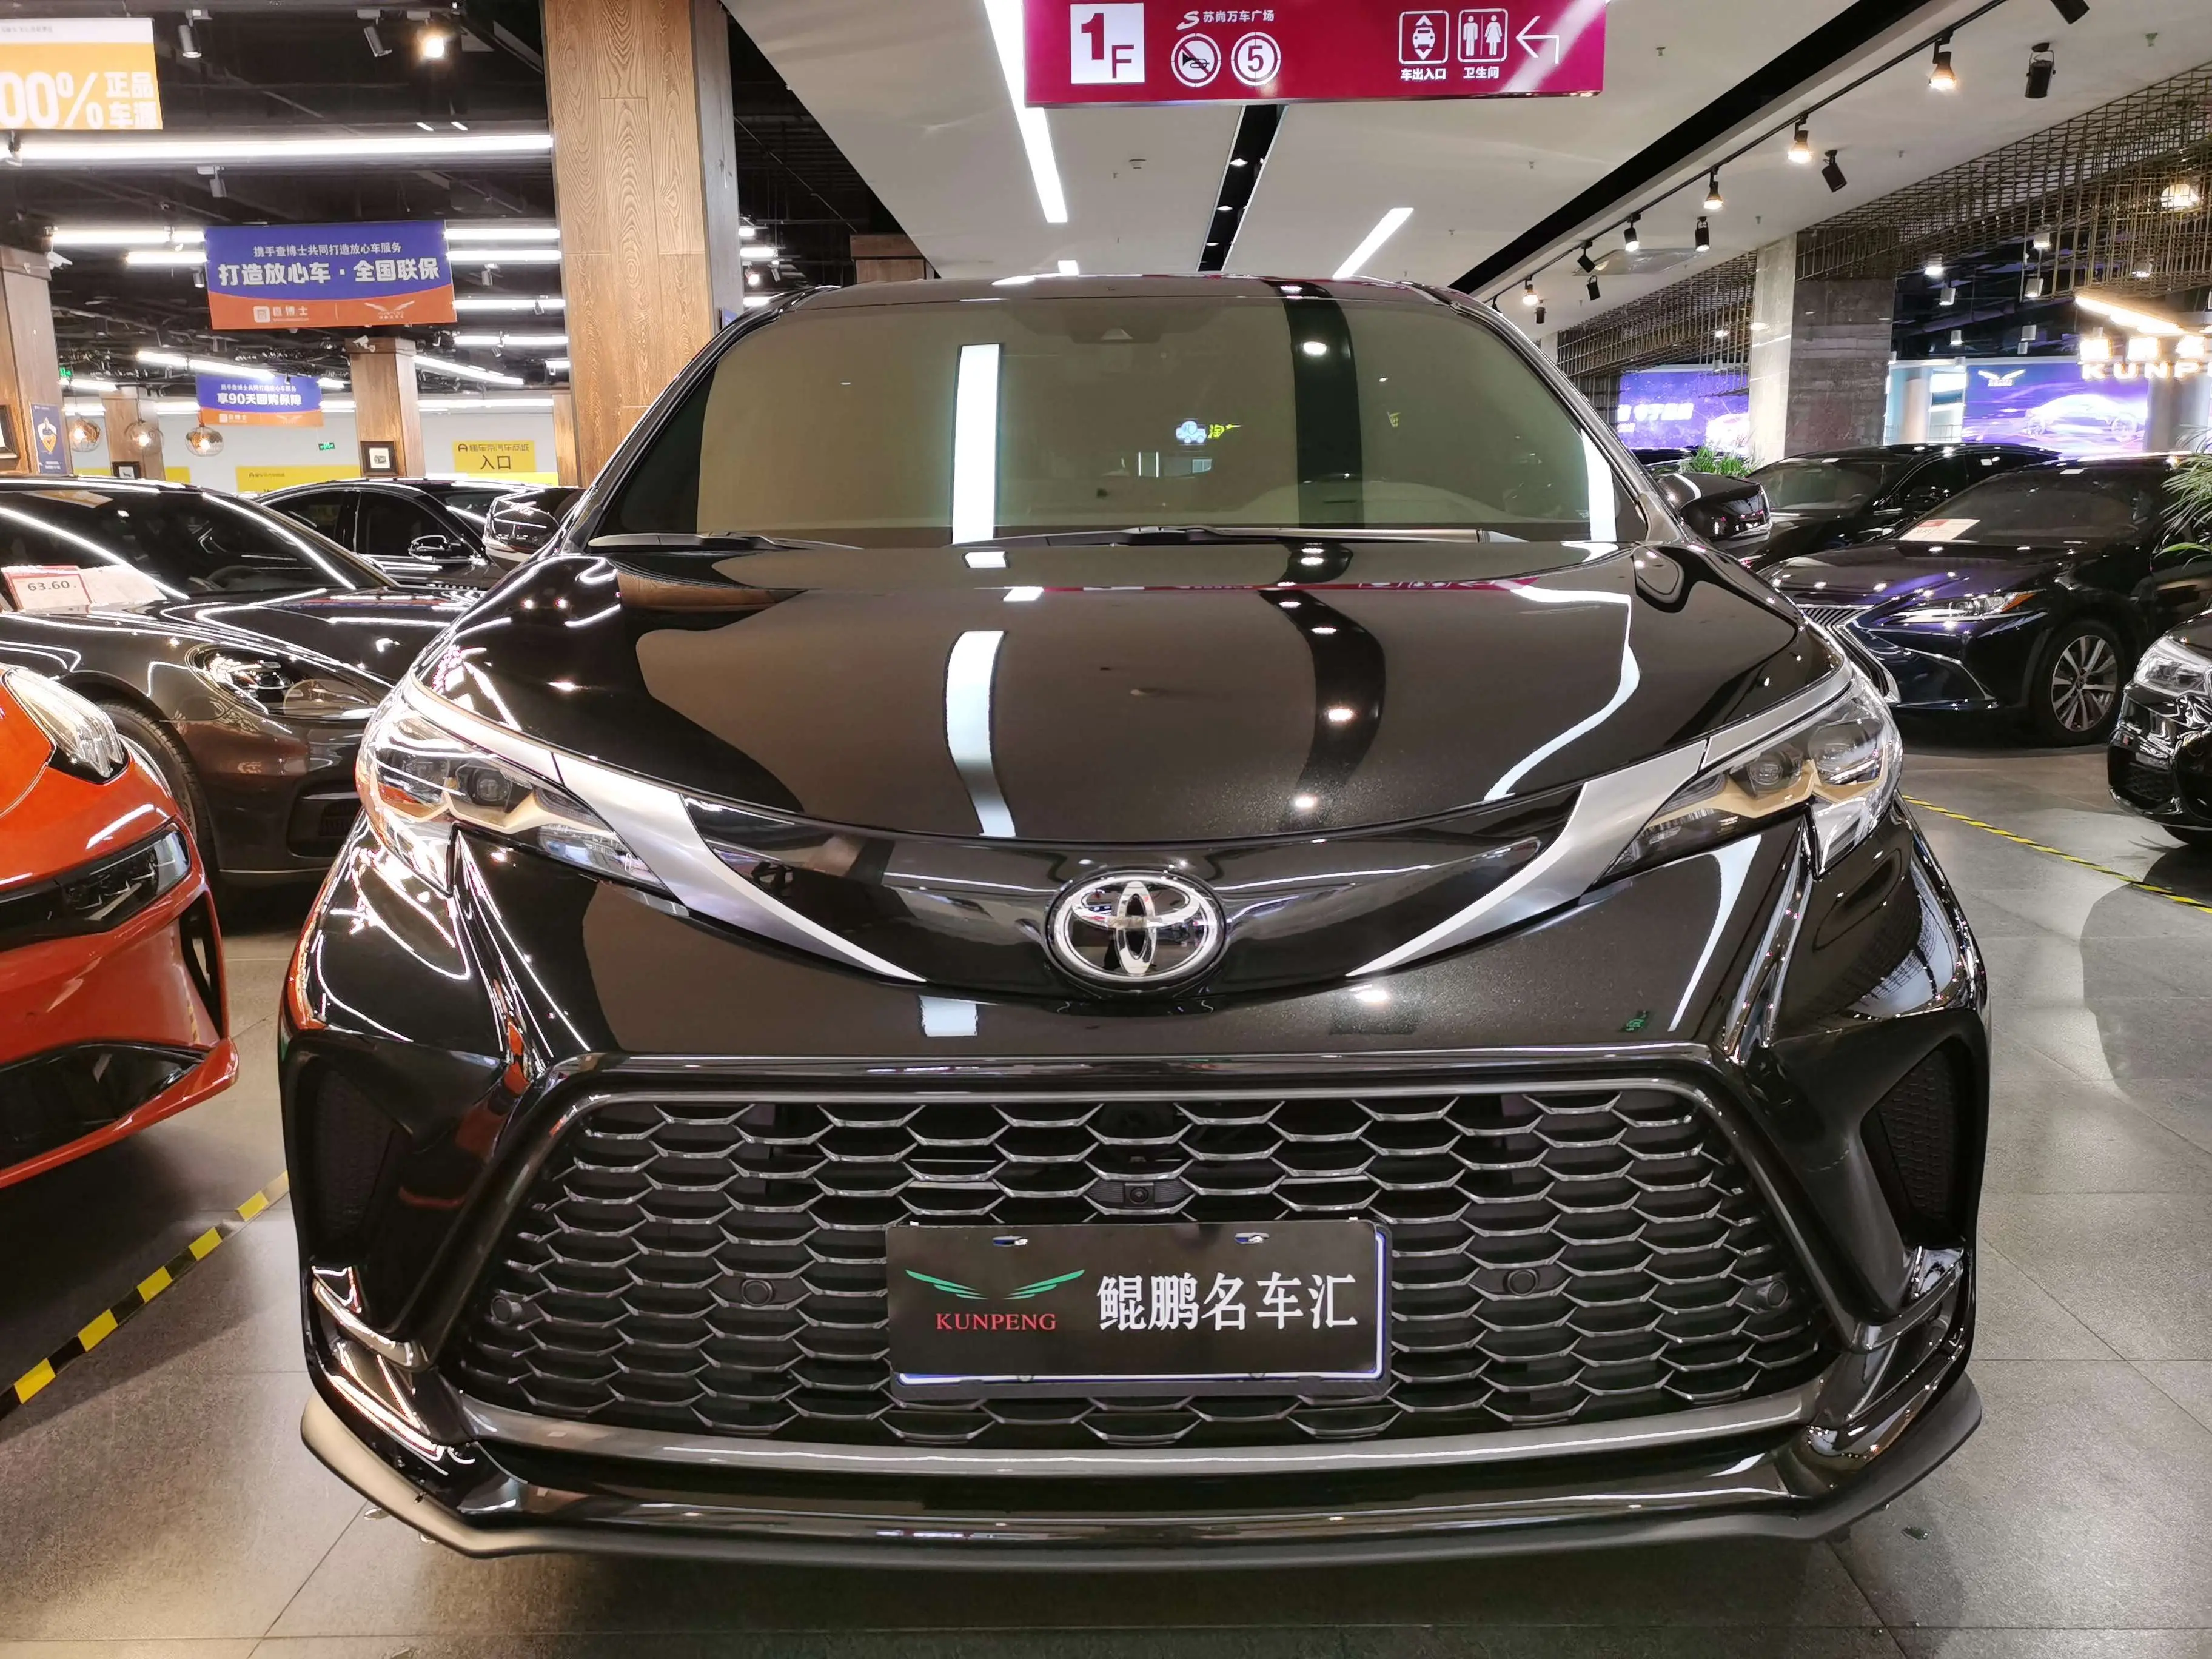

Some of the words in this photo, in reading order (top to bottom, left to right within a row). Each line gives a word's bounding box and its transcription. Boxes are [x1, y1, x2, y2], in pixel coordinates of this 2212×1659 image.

[1203, 10, 1275, 23] 苏尚万车广场
[1247, 45, 1265, 72] 5
[1400, 68, 1447, 81] 车出入口
[1463, 66, 1500, 79] 卫生间
[104, 71, 155, 98] 正品
[253, 241, 402, 258] 携手查博士共同打造放心车服务
[2082, 361, 2212, 380] KUNP
[480, 455, 512, 470] 入口
[1097, 1272, 1358, 1331] 鲲鹏名车汇
[936, 1313, 1057, 1331] KUNPENG
